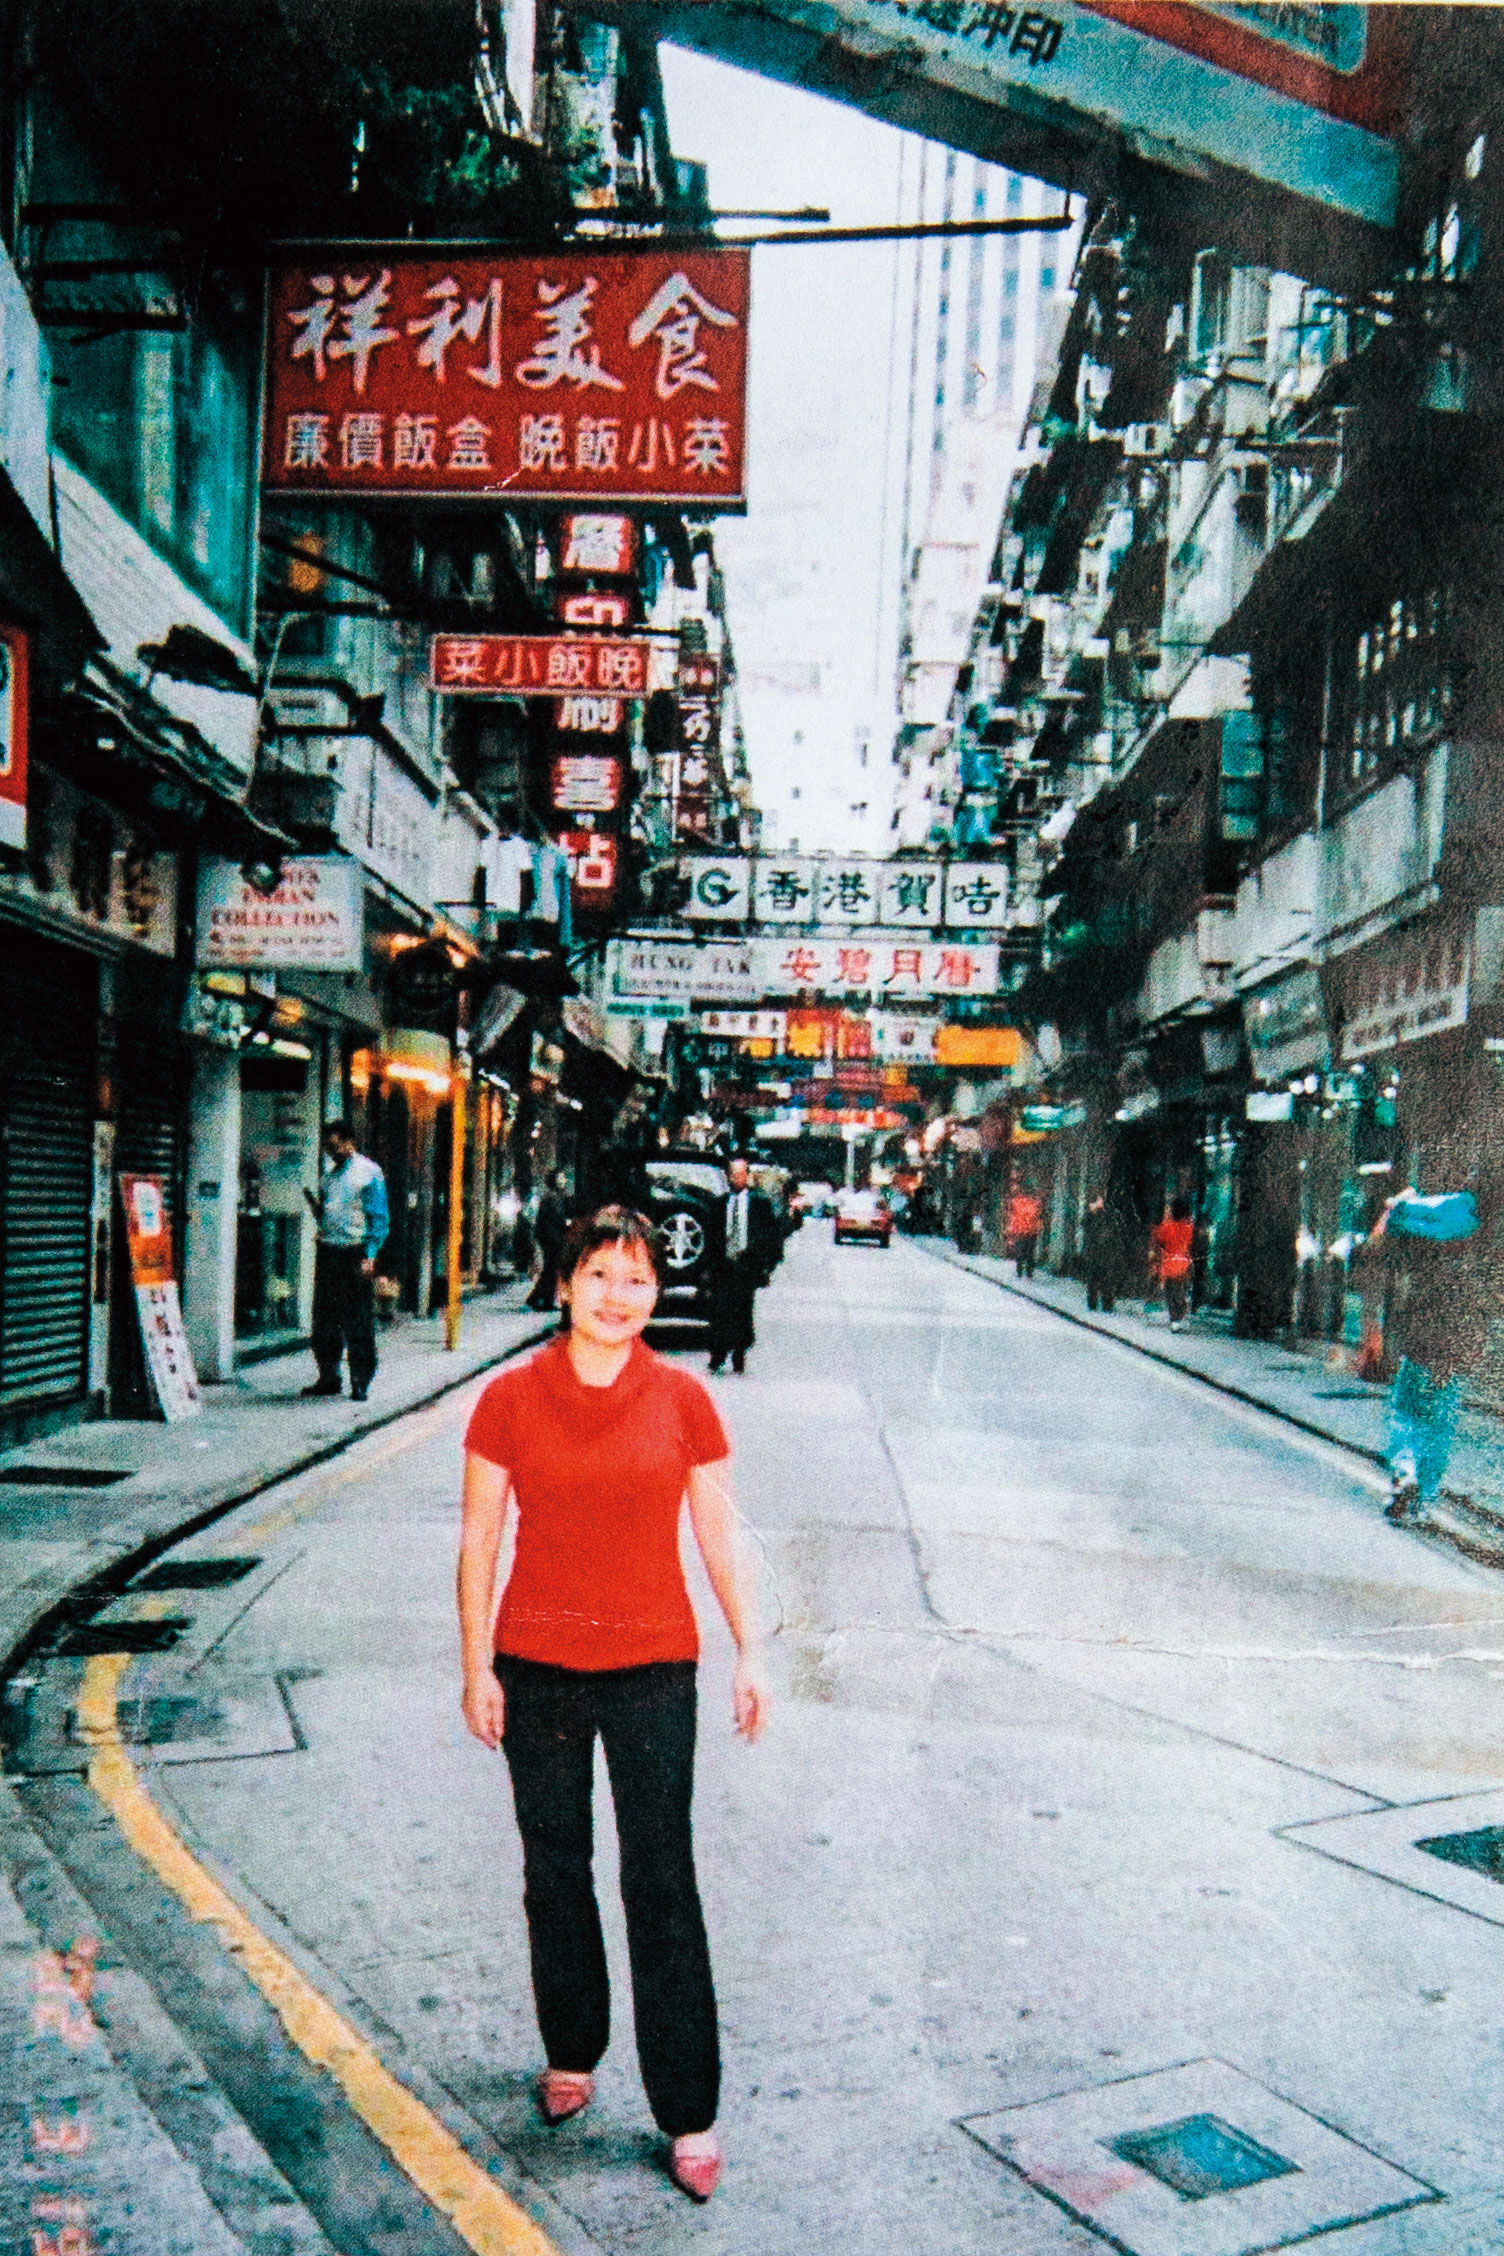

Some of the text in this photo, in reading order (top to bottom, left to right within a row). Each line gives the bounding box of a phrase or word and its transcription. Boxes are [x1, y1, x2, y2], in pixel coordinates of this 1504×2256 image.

[286, 267, 740, 400] 祥利美食
[284, 412, 731, 475] 廉價飯盒 晚飯小菜
[757, 868, 1002, 917] 香港賀咭
